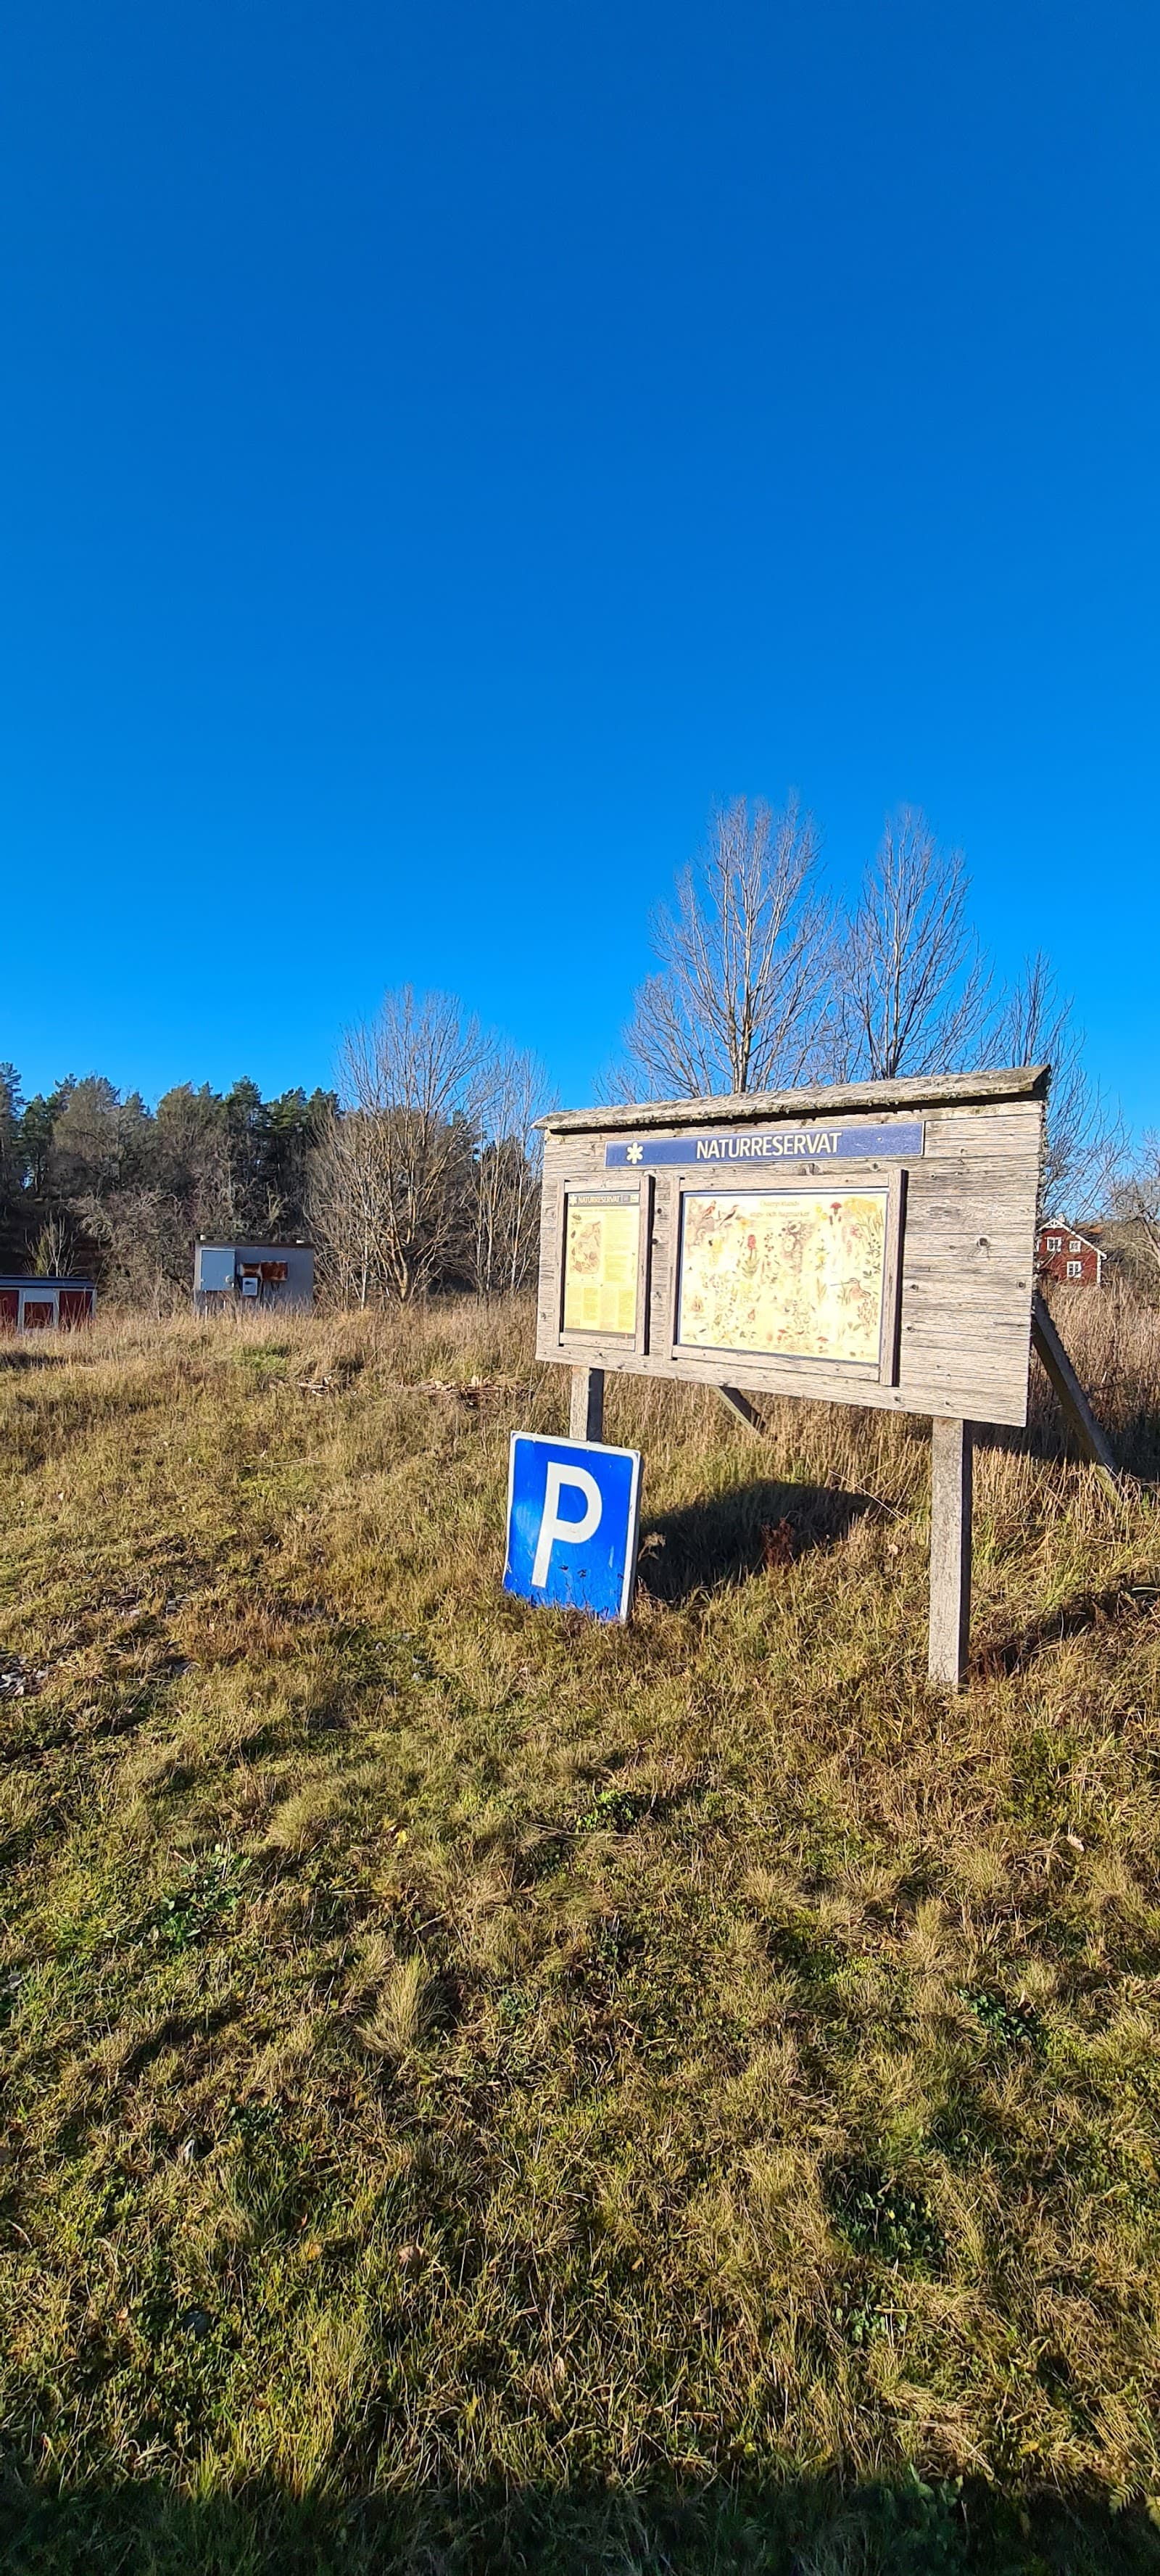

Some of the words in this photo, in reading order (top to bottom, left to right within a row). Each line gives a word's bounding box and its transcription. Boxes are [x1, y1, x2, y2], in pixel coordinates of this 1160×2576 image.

[696, 1132, 842, 1159] NATURRESERVAT
[578, 1195, 621, 1204] NATURRESERVAT
[531, 1461, 602, 1588] P
